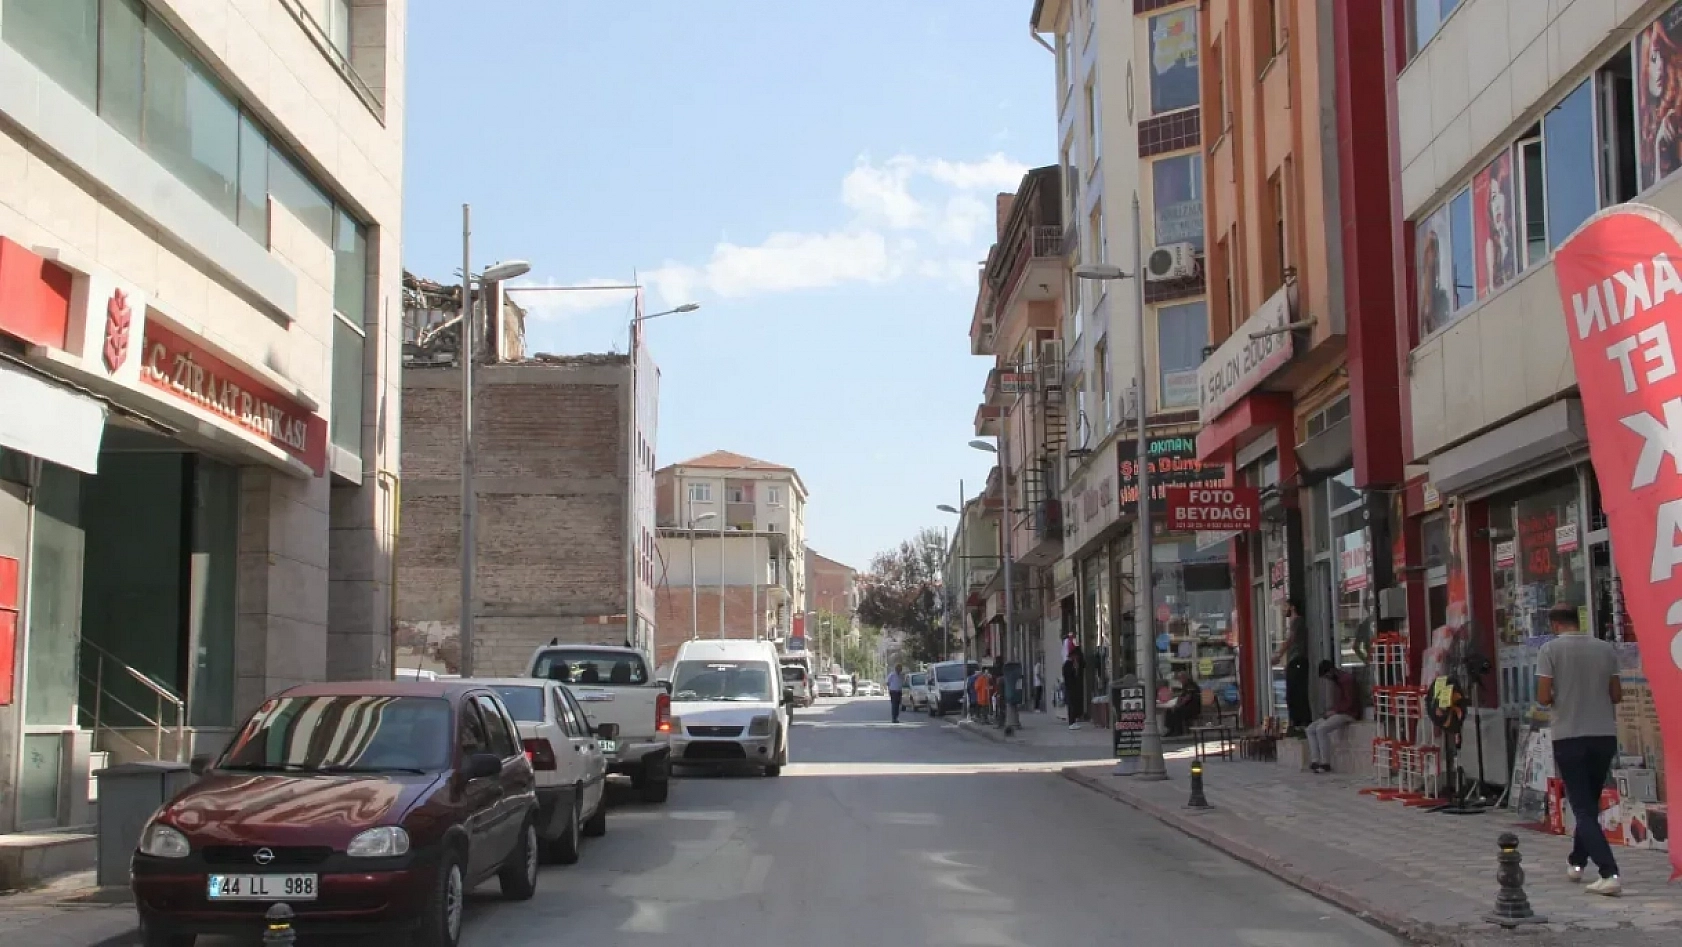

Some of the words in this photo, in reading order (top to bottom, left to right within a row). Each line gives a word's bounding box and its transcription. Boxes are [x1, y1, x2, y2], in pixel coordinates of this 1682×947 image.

[1209, 352, 1240, 404] SALON
[173, 352, 239, 417] ZİRAAT
[241, 391, 307, 450] BANKASI
[1148, 438, 1193, 454] OKMAN
[1189, 489, 1234, 504] FOTO
[1175, 504, 1251, 520] BEYDAĞI
[221, 877, 240, 895] 44
[250, 877, 269, 895] LL
[284, 877, 313, 895] 988
